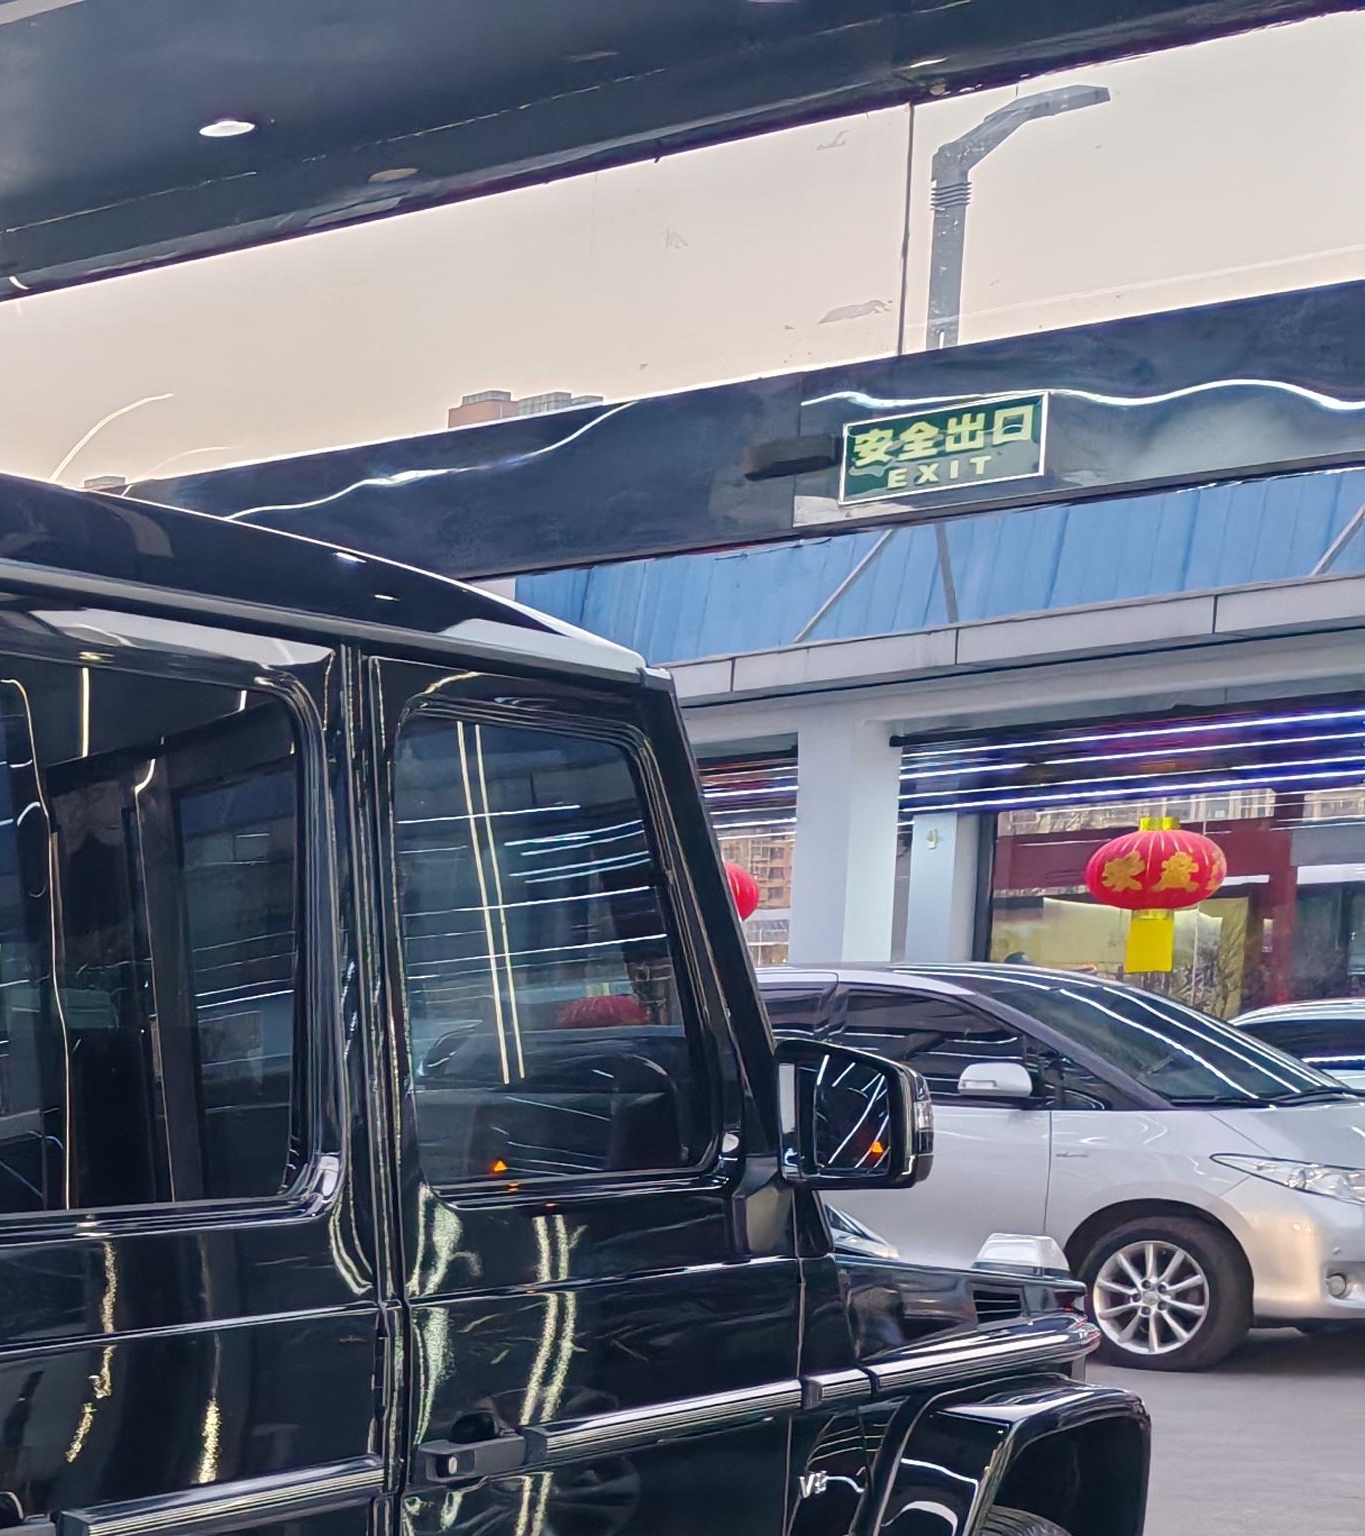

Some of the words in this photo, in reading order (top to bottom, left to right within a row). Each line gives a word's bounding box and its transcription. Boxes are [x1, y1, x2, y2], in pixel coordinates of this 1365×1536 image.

[853, 405, 1034, 467] 安全出口
[887, 455, 992, 489] EXIT
